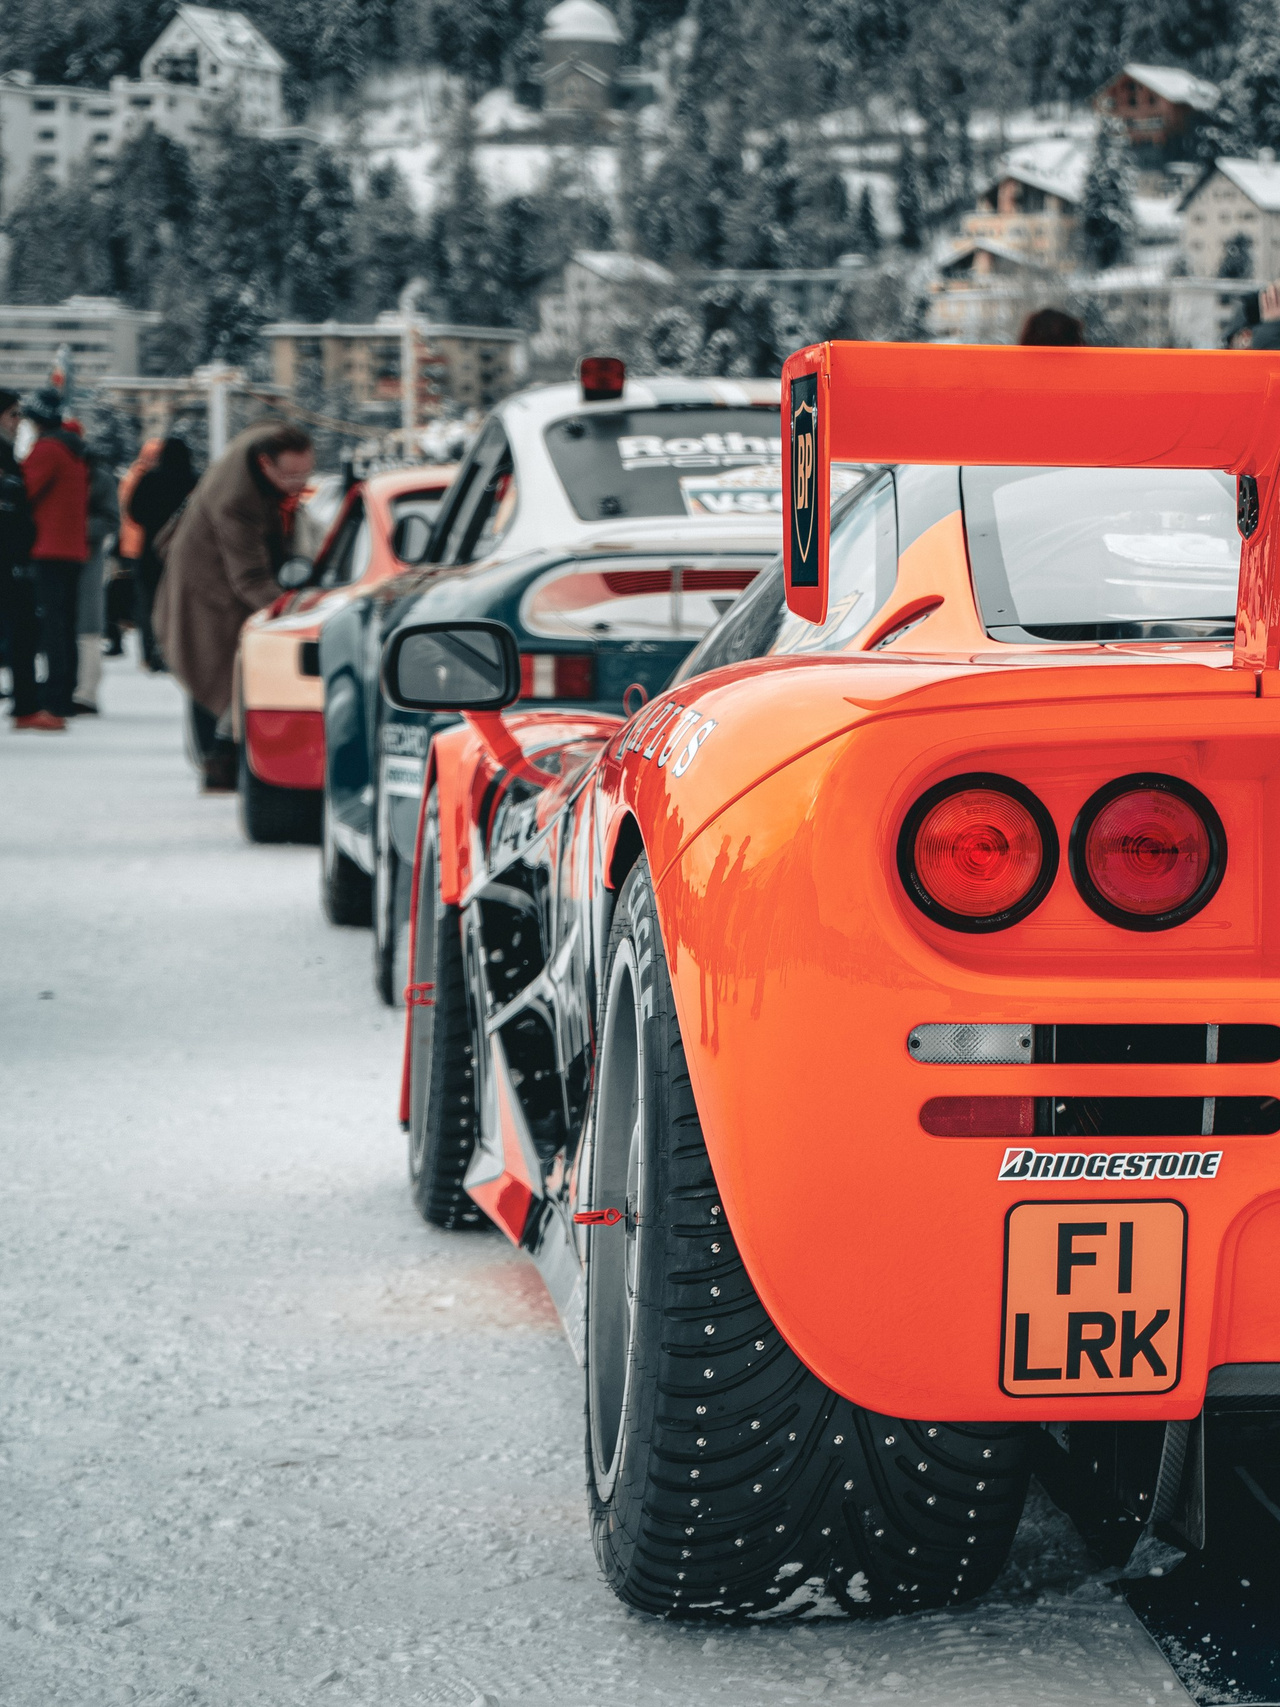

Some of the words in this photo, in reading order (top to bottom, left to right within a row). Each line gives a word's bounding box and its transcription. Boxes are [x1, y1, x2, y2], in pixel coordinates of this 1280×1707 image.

[796, 432, 813, 511] BP
[999, 1148, 1221, 1180] BRIDGESTONE
[1013, 1308, 1171, 1382] LRK
